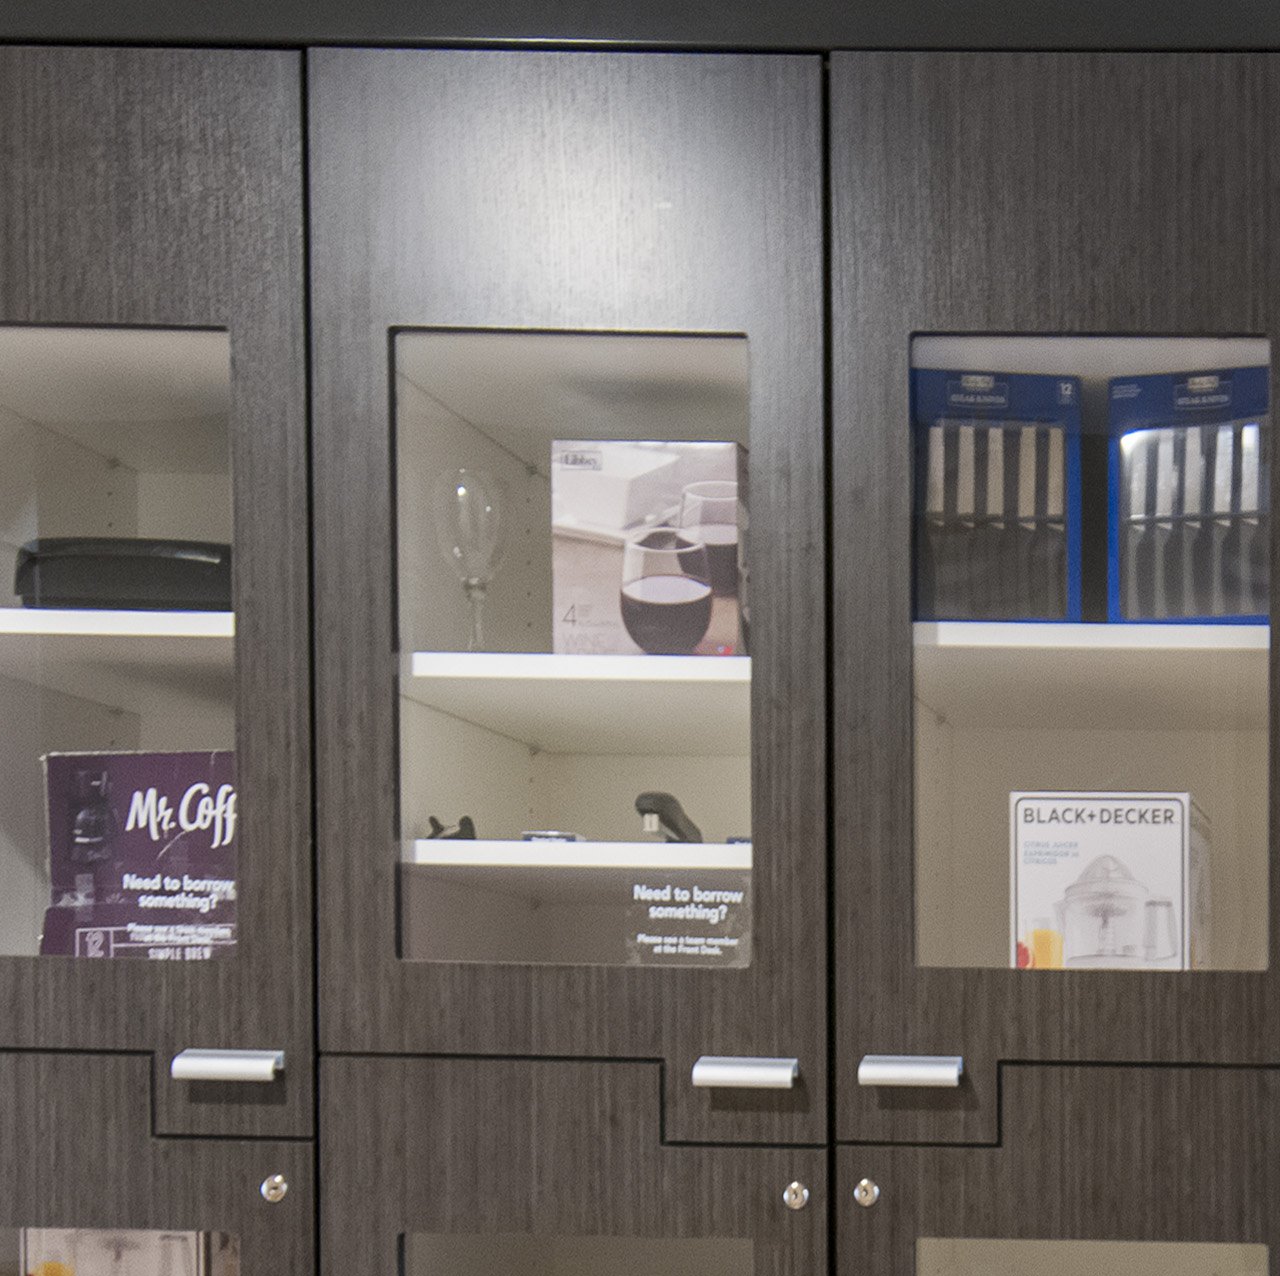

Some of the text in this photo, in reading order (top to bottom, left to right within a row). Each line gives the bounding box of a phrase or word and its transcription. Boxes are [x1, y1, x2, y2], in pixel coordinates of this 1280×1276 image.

[1023, 807, 1175, 825] BLACK+DECKER
[123, 873, 161, 890] Need
[163, 876, 181, 891] to
[633, 884, 744, 903] Need to borrow
[648, 902, 728, 924] something?
